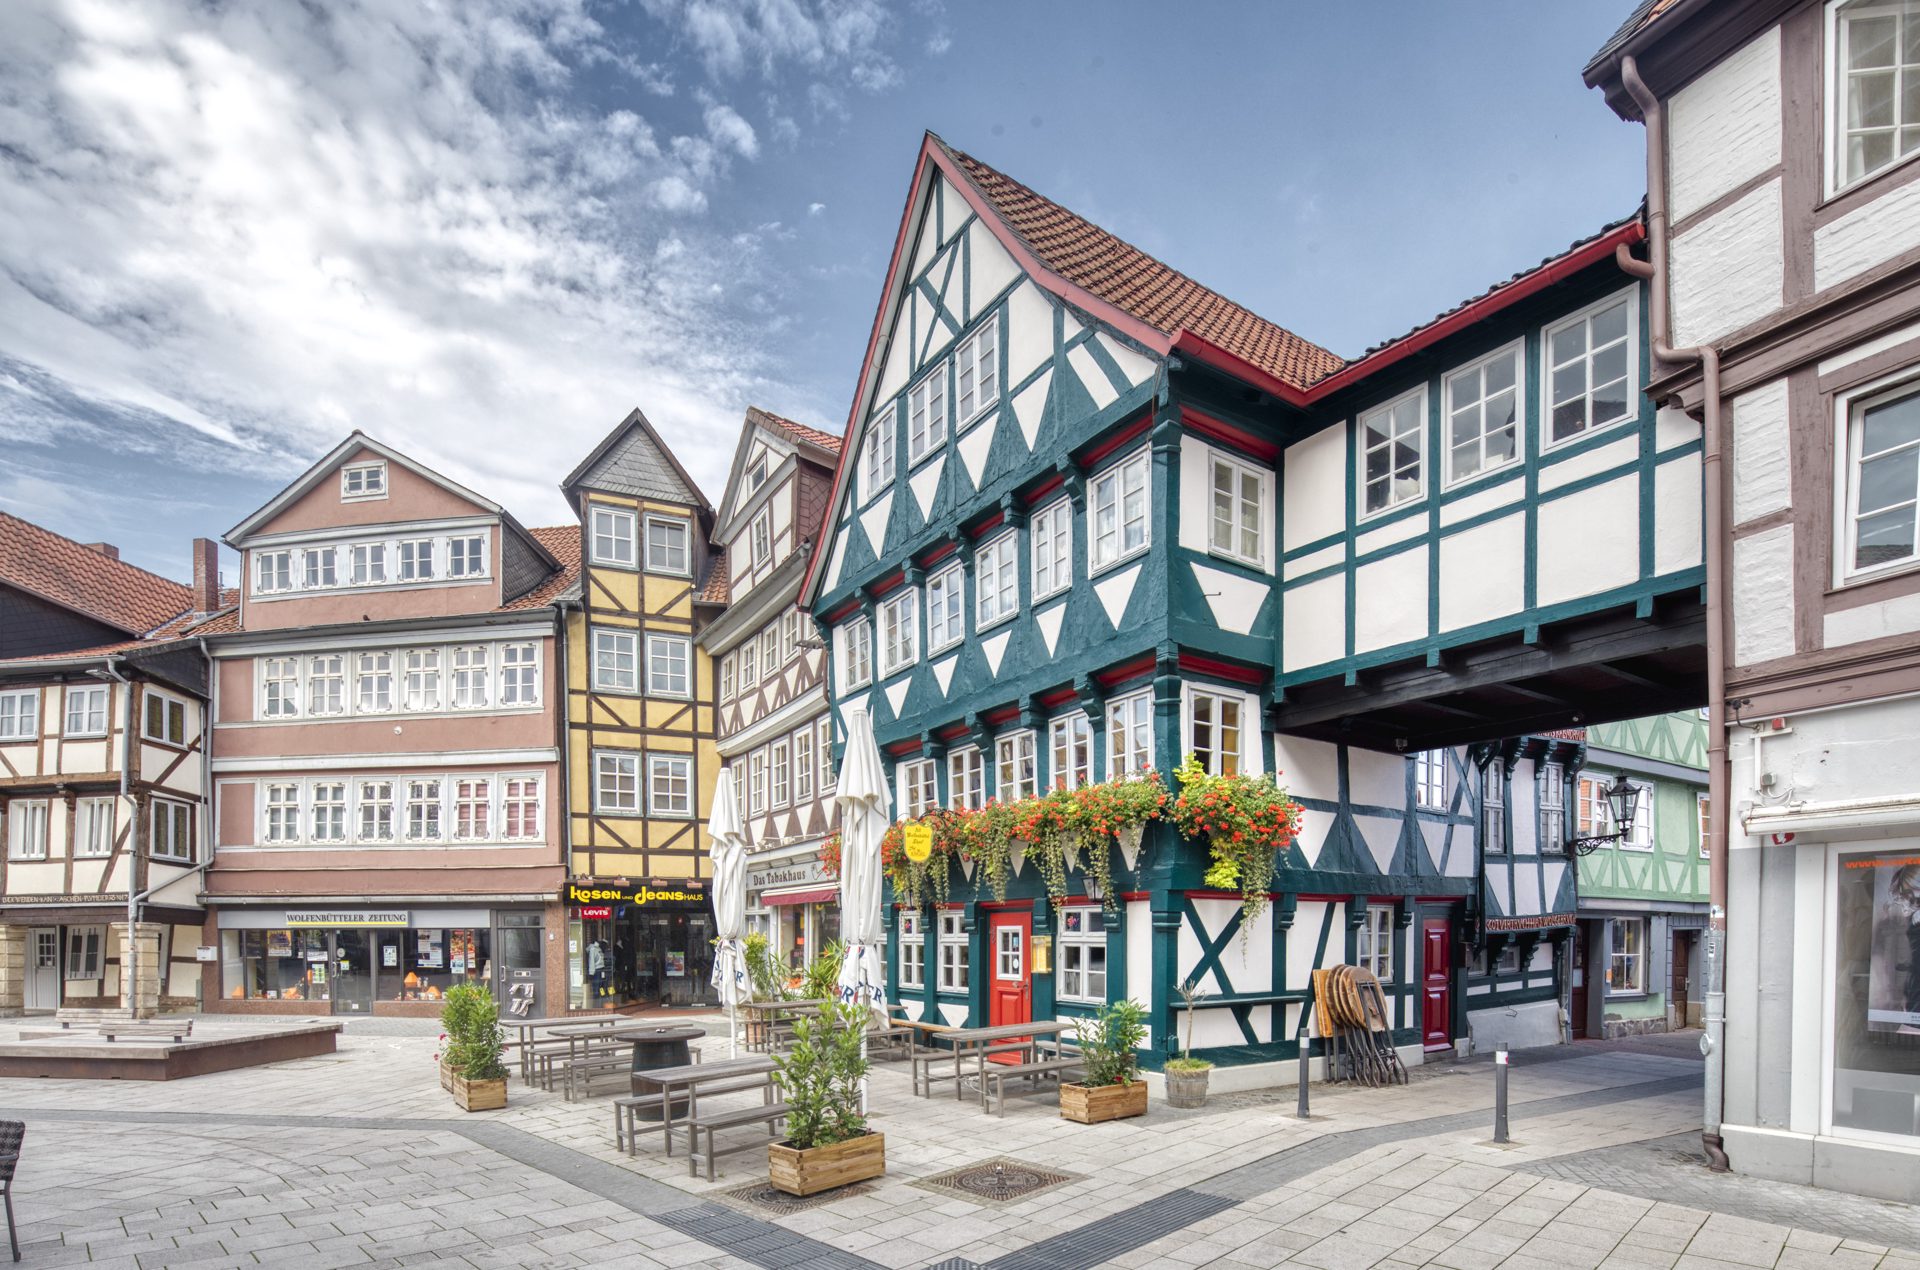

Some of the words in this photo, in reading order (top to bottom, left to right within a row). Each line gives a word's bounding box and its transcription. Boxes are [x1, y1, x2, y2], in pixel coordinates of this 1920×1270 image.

[753, 875, 766, 886] Das
[766, 870, 806, 884] Tabakhaus
[286, 912, 365, 922] WOLFENBÜTTELER
[368, 914, 407, 922] ZEITUNG
